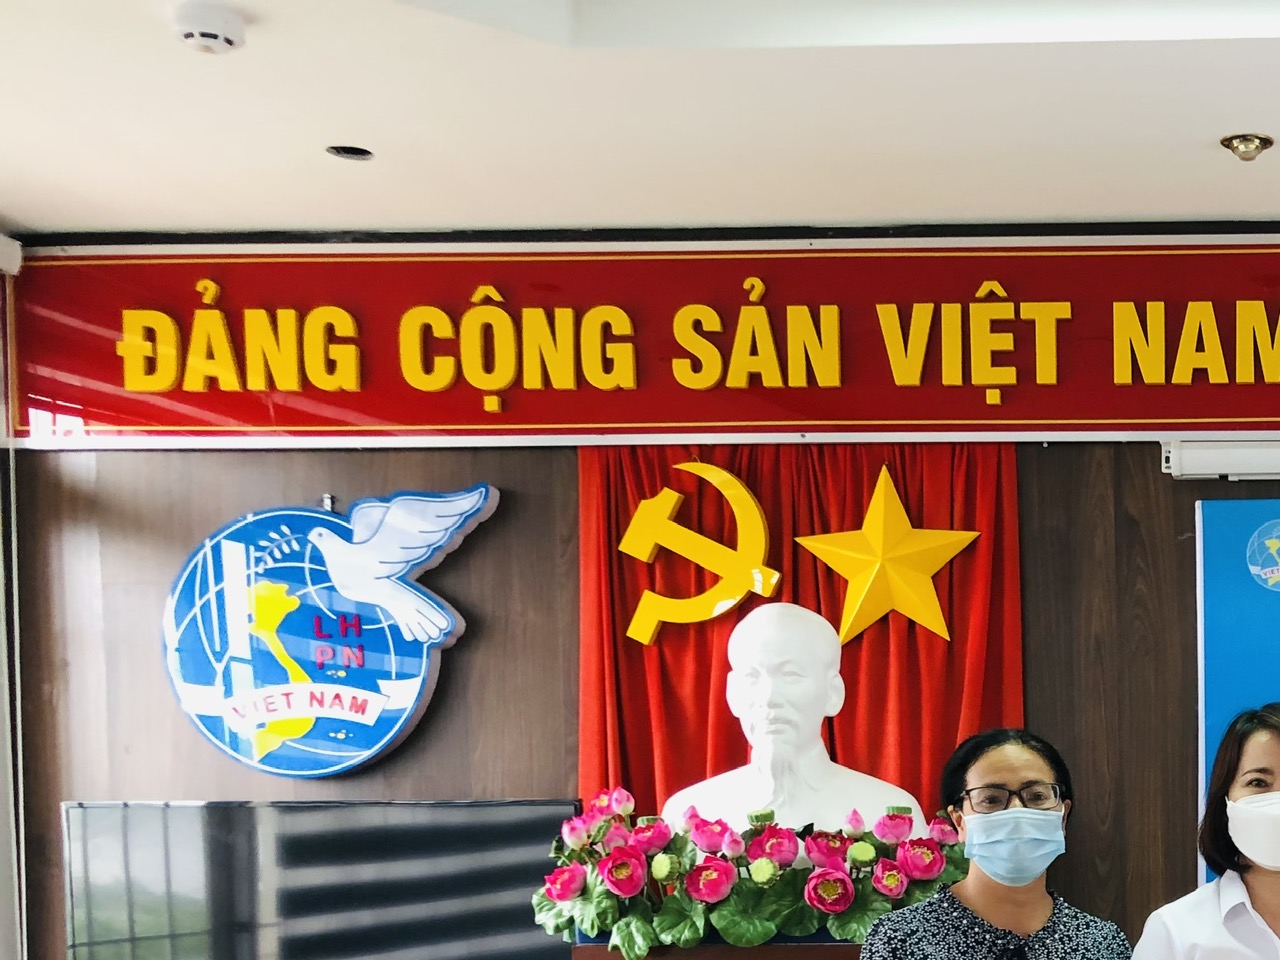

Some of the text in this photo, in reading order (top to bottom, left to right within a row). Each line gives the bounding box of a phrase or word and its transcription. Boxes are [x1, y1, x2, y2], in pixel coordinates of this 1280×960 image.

[116, 278, 361, 393] ĐẢNG
[400, 285, 637, 413] CỘNG
[672, 276, 842, 390] SẢN
[876, 280, 1072, 405] VIỆT
[313, 613, 362, 639] LH
[315, 643, 365, 670] PN
[309, 690, 368, 715] NAM
